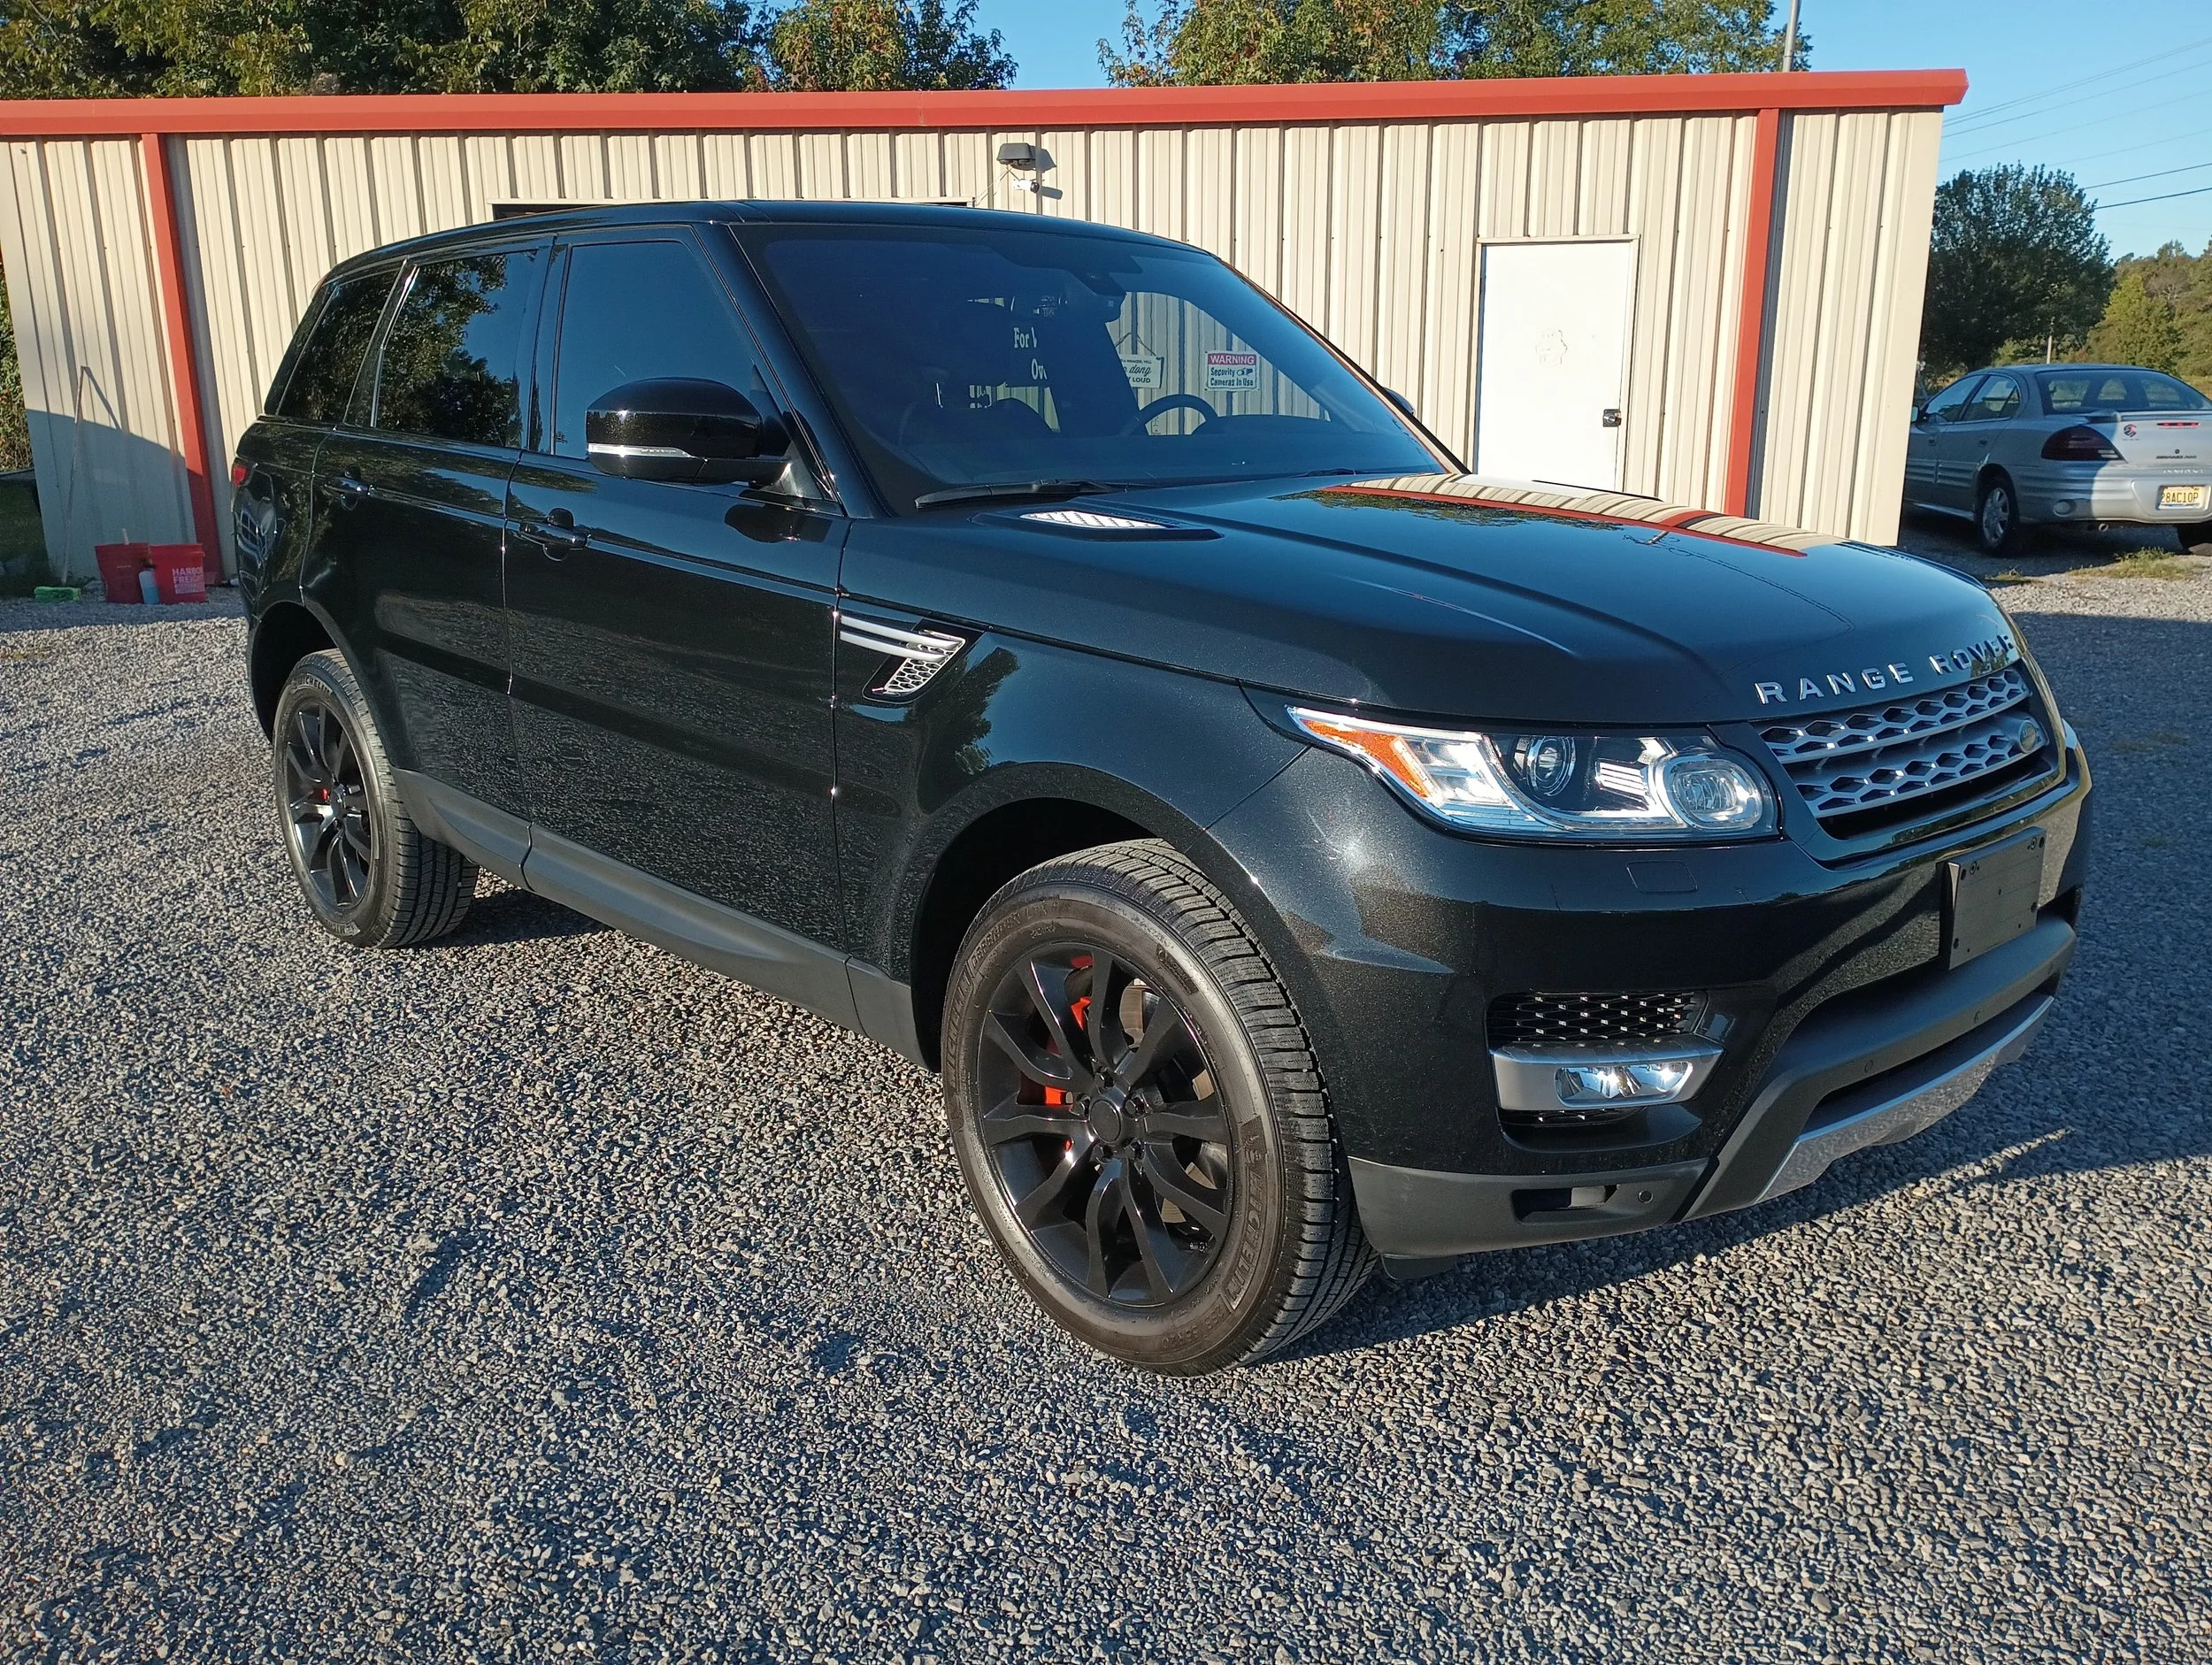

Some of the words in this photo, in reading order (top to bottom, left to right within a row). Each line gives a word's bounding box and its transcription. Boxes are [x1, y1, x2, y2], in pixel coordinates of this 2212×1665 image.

[1013, 326, 1030, 349] For
[1210, 355, 1255, 364] WARNING
[1210, 366, 1235, 378] Security
[1210, 377, 1235, 387] Cameras
[1242, 377, 1254, 387] Use
[1928, 634, 2015, 675] ROVER
[1755, 663, 1914, 705] RANGE
[1225, 1169, 1263, 1303] MICHELIN
